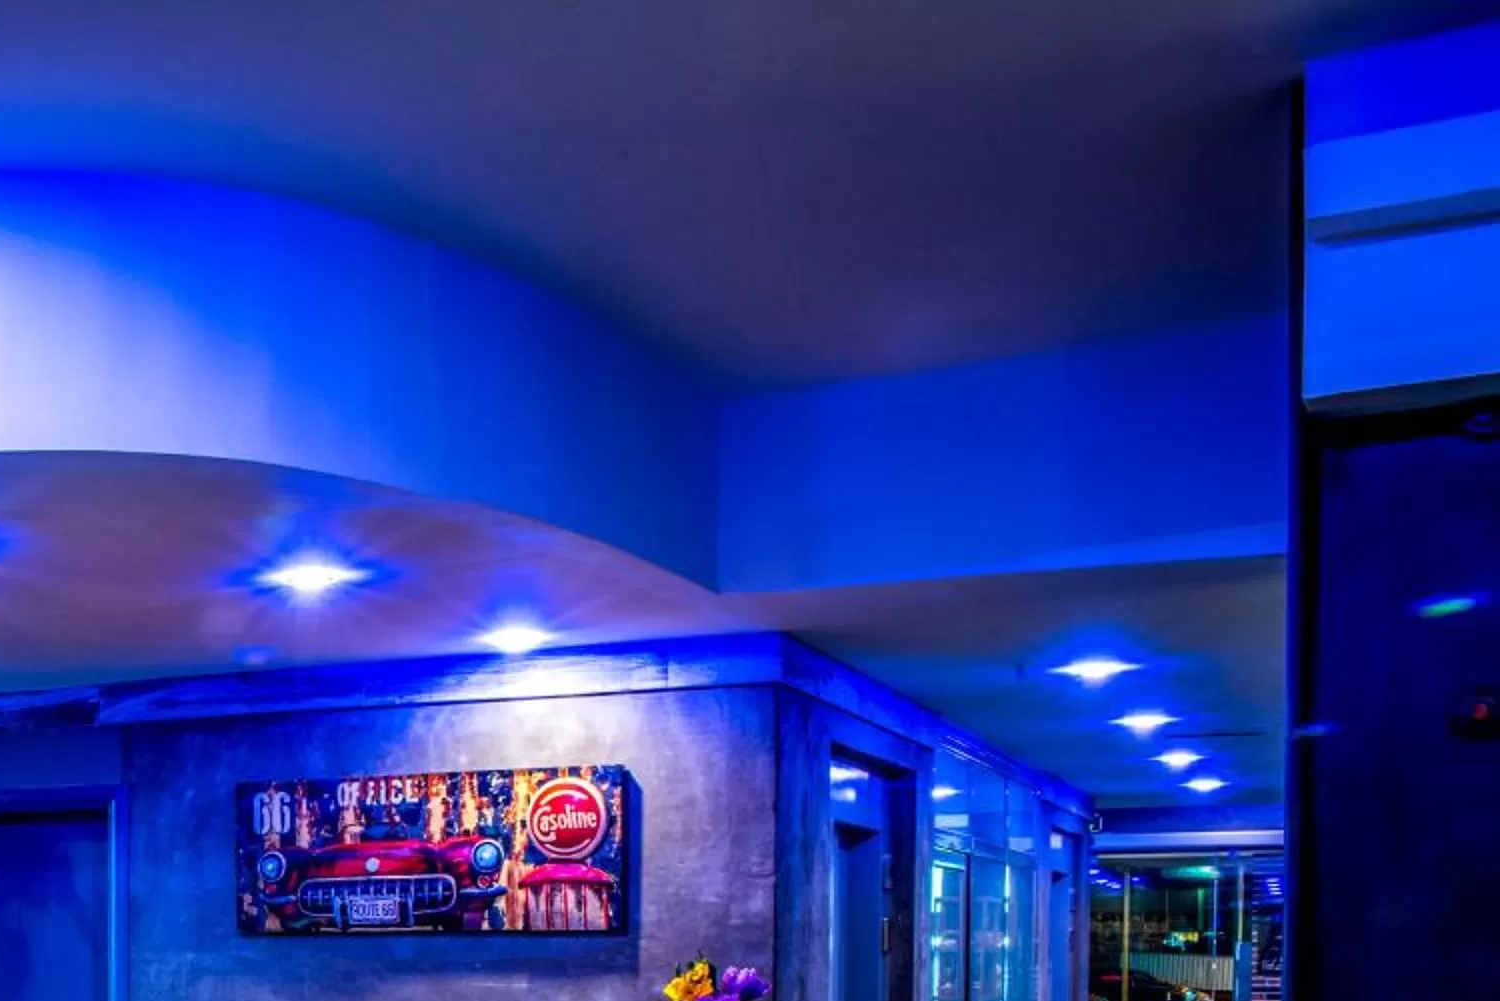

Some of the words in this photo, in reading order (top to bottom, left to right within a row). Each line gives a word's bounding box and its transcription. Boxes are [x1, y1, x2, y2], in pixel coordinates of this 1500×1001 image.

[253, 791, 291, 835] 66
[533, 803, 597, 842] Gasoline
[352, 903, 380, 917] ROUTE
[381, 903, 395, 917] 66
